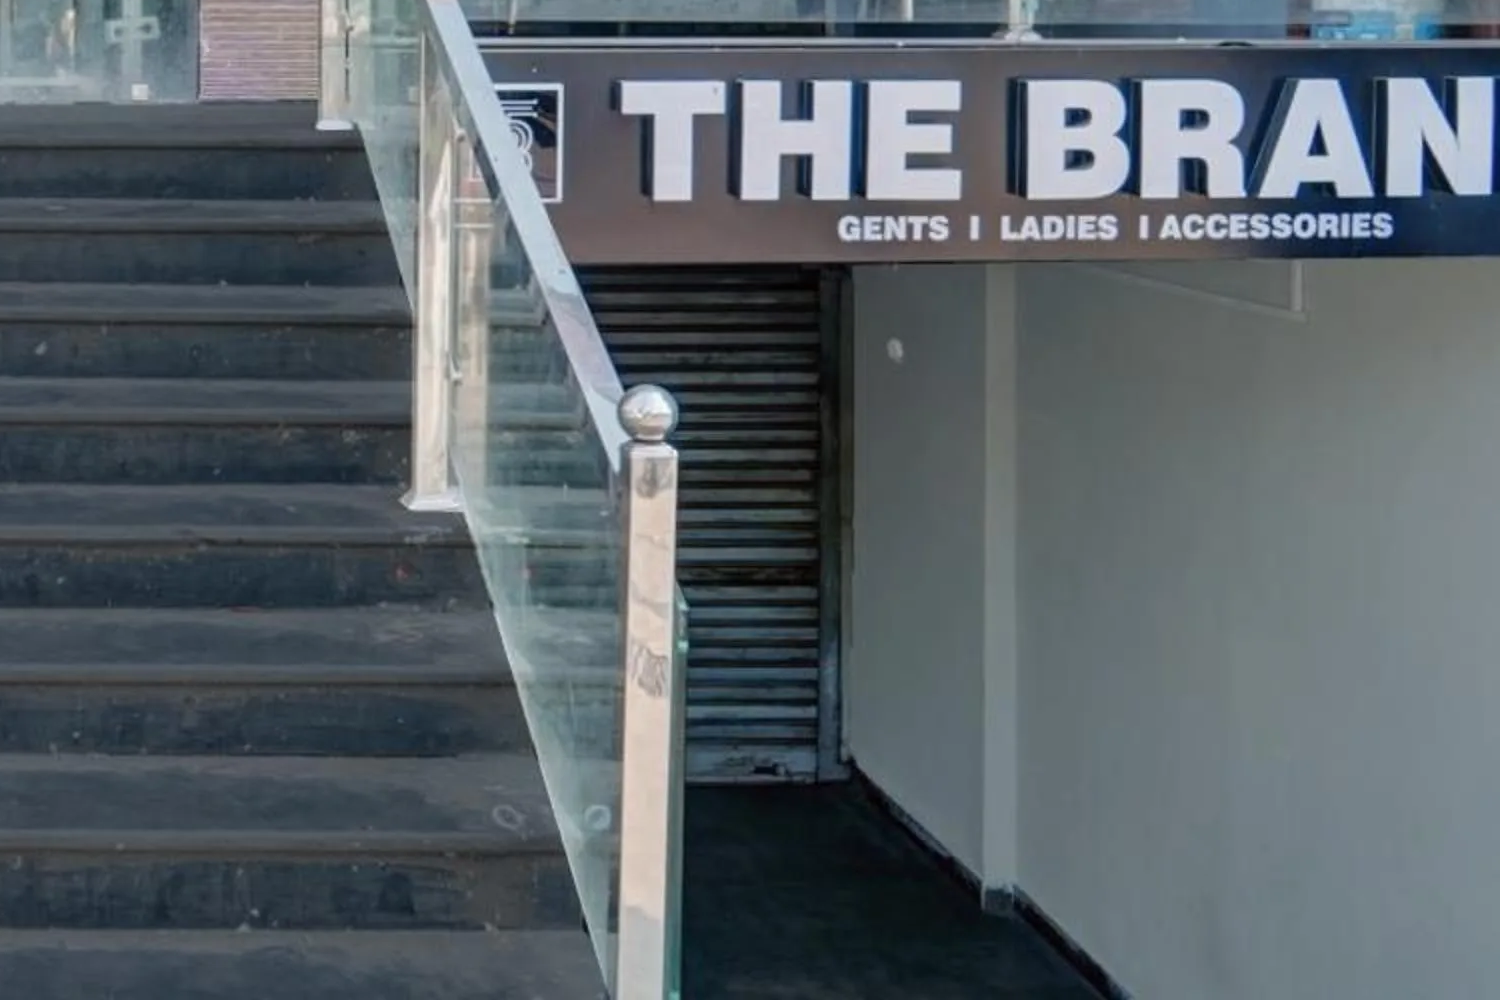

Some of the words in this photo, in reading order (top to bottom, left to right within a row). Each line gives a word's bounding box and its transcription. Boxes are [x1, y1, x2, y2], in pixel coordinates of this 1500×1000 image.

[618, 78, 963, 201] THE
[1026, 76, 1494, 199] BRAN
[837, 214, 949, 243] GENTS
[999, 213, 1119, 242] LADIES
[1159, 212, 1394, 242] ACCESSORIES
